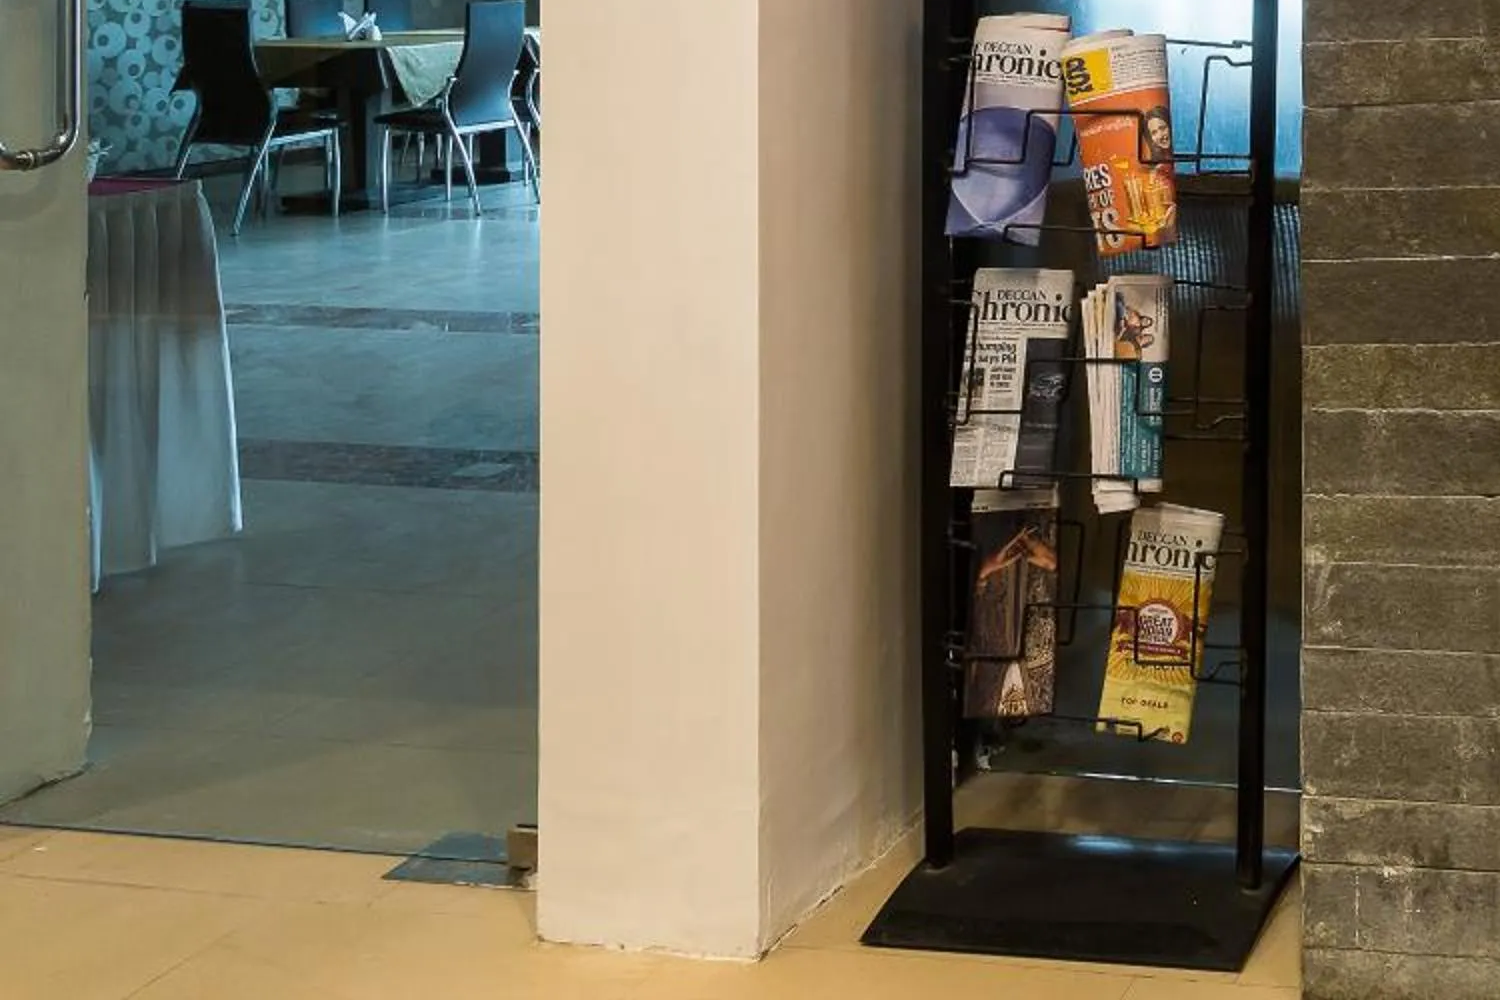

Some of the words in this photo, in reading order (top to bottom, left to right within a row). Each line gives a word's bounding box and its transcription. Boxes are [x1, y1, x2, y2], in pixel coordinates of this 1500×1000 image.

[983, 41, 1032, 55] DECCAN
[997, 290, 1047, 301] DECCAN
[1138, 531, 1188, 545] DECCAN
